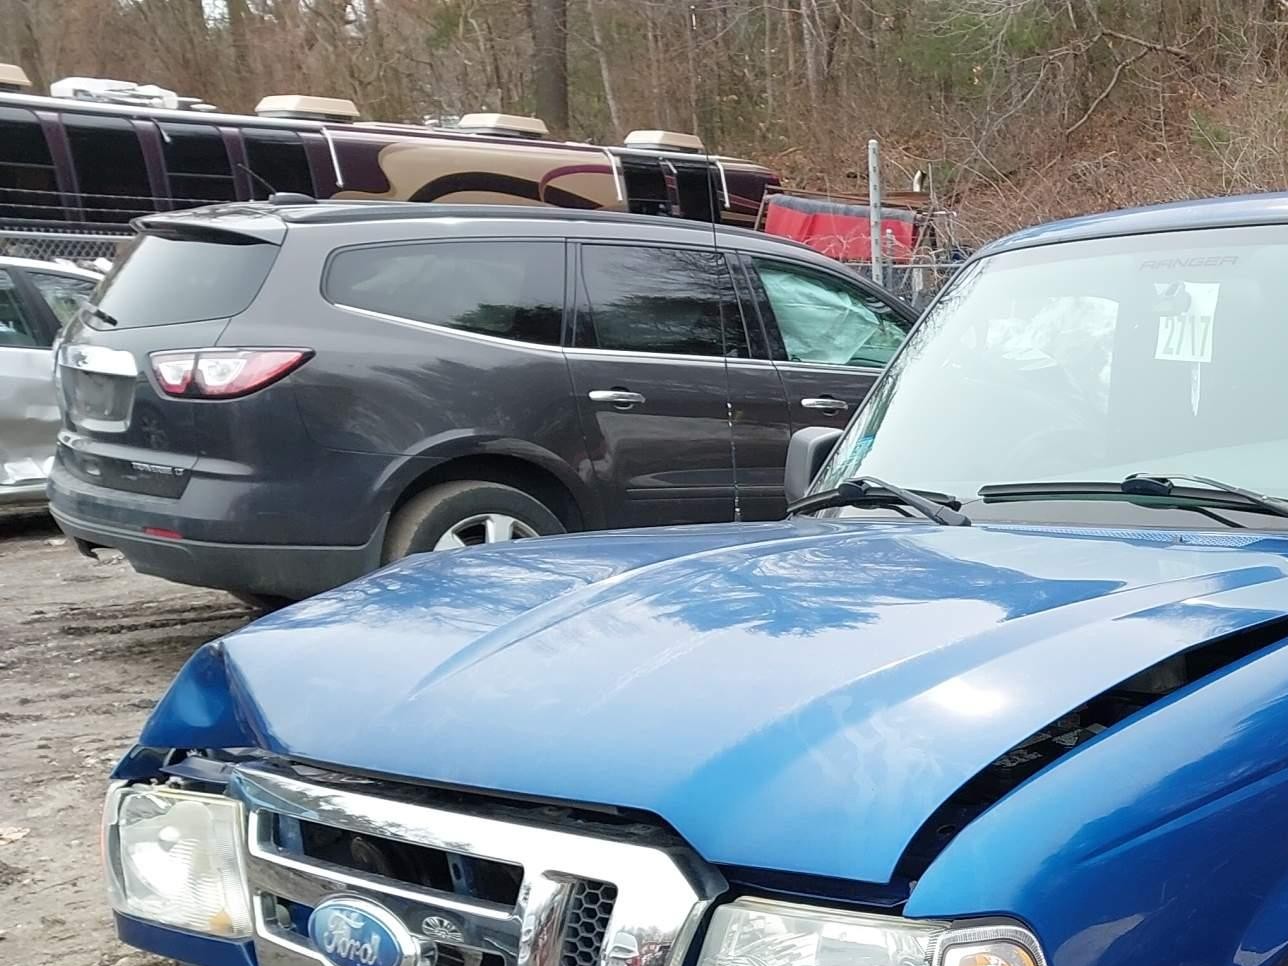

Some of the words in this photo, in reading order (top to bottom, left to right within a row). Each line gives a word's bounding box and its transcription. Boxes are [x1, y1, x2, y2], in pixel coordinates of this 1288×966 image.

[1140, 255, 1239, 271] RANGER
[1161, 315, 1212, 357] 2717
[323, 909, 382, 966] Ford
